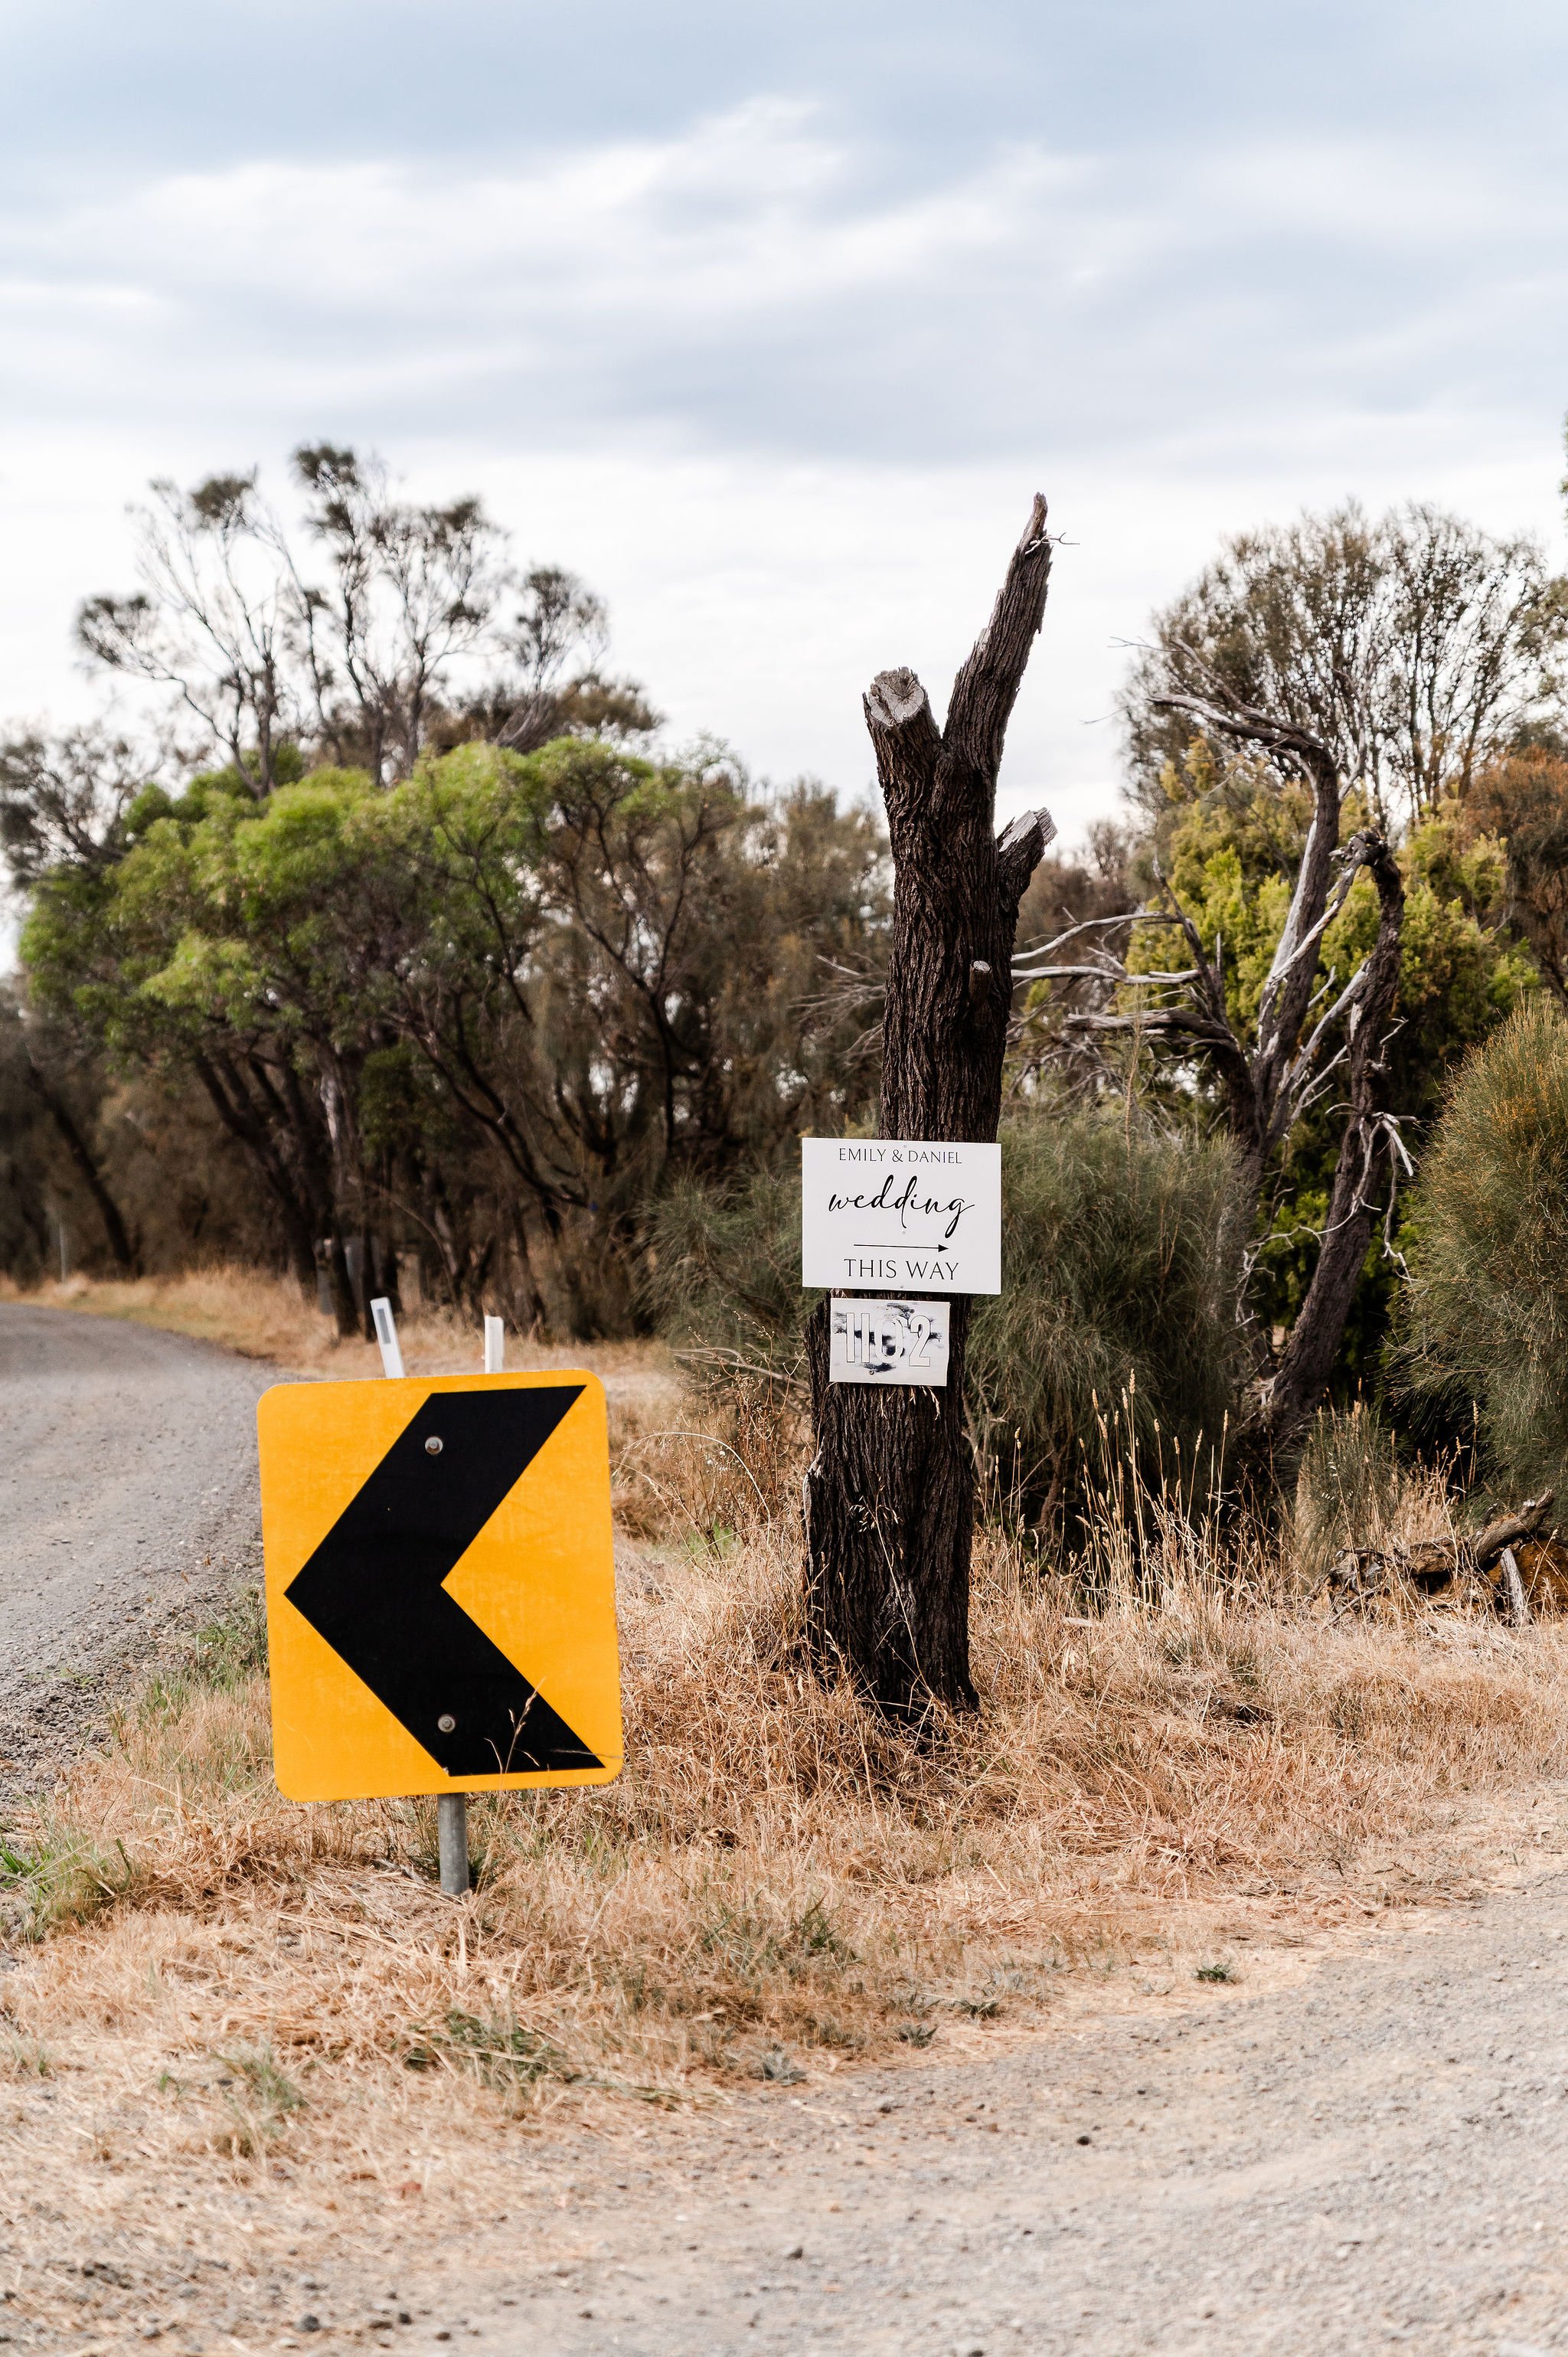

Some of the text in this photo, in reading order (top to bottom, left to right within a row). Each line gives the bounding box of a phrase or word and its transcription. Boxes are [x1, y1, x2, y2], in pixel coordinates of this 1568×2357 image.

[839, 1147, 962, 1164] EMILY & DANIEL
[828, 1174, 975, 1239] wedding
[844, 1259, 959, 1280] THIS WAY
